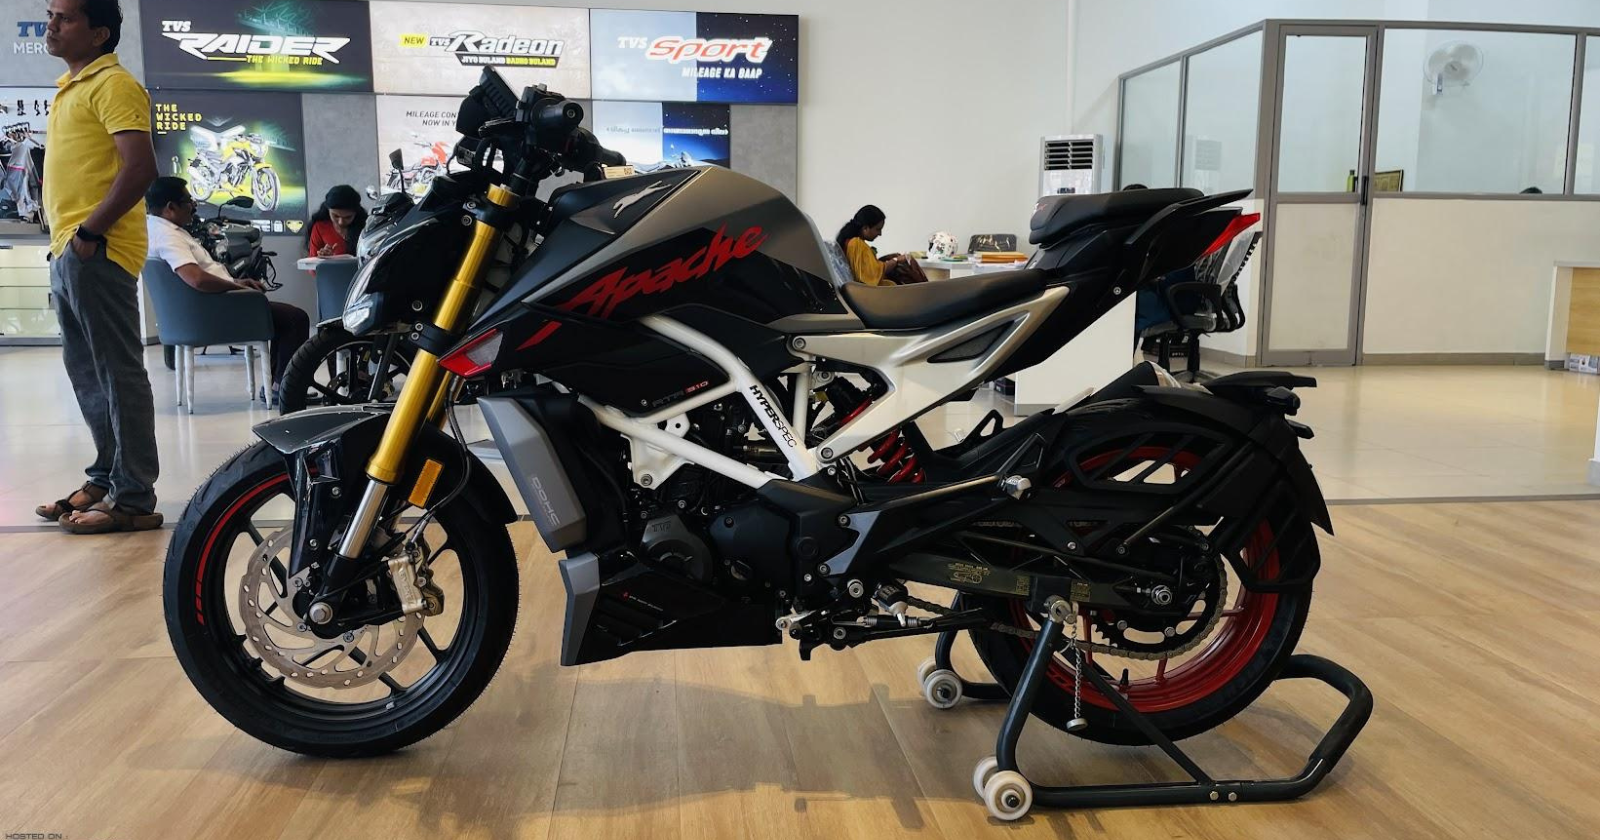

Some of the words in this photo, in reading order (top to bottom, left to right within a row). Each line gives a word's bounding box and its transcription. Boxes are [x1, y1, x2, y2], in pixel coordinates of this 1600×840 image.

[162, 21, 191, 32] TVS
[162, 33, 350, 64] RAIDER
[403, 36, 425, 45] NEW
[430, 37, 450, 46] TVS
[445, 30, 565, 55] Radeon
[617, 37, 648, 49] TVS
[647, 36, 771, 63] Sport
[246, 55, 263, 64] THE
[267, 56, 300, 65] WICKED
[303, 57, 323, 65] RIDE
[681, 67, 722, 78] MILEAGE
[723, 67, 736, 78] KA
[738, 68, 763, 79] BAAP
[155, 103, 178, 112] THE
[155, 112, 203, 122] WICKED
[405, 110, 440, 118] MILEAGE
[156, 121, 186, 130] RIDE
[555, 222, 770, 321] Apache
[749, 384, 798, 448] HYPERSPEC
[531, 476, 561, 527] DOHC
